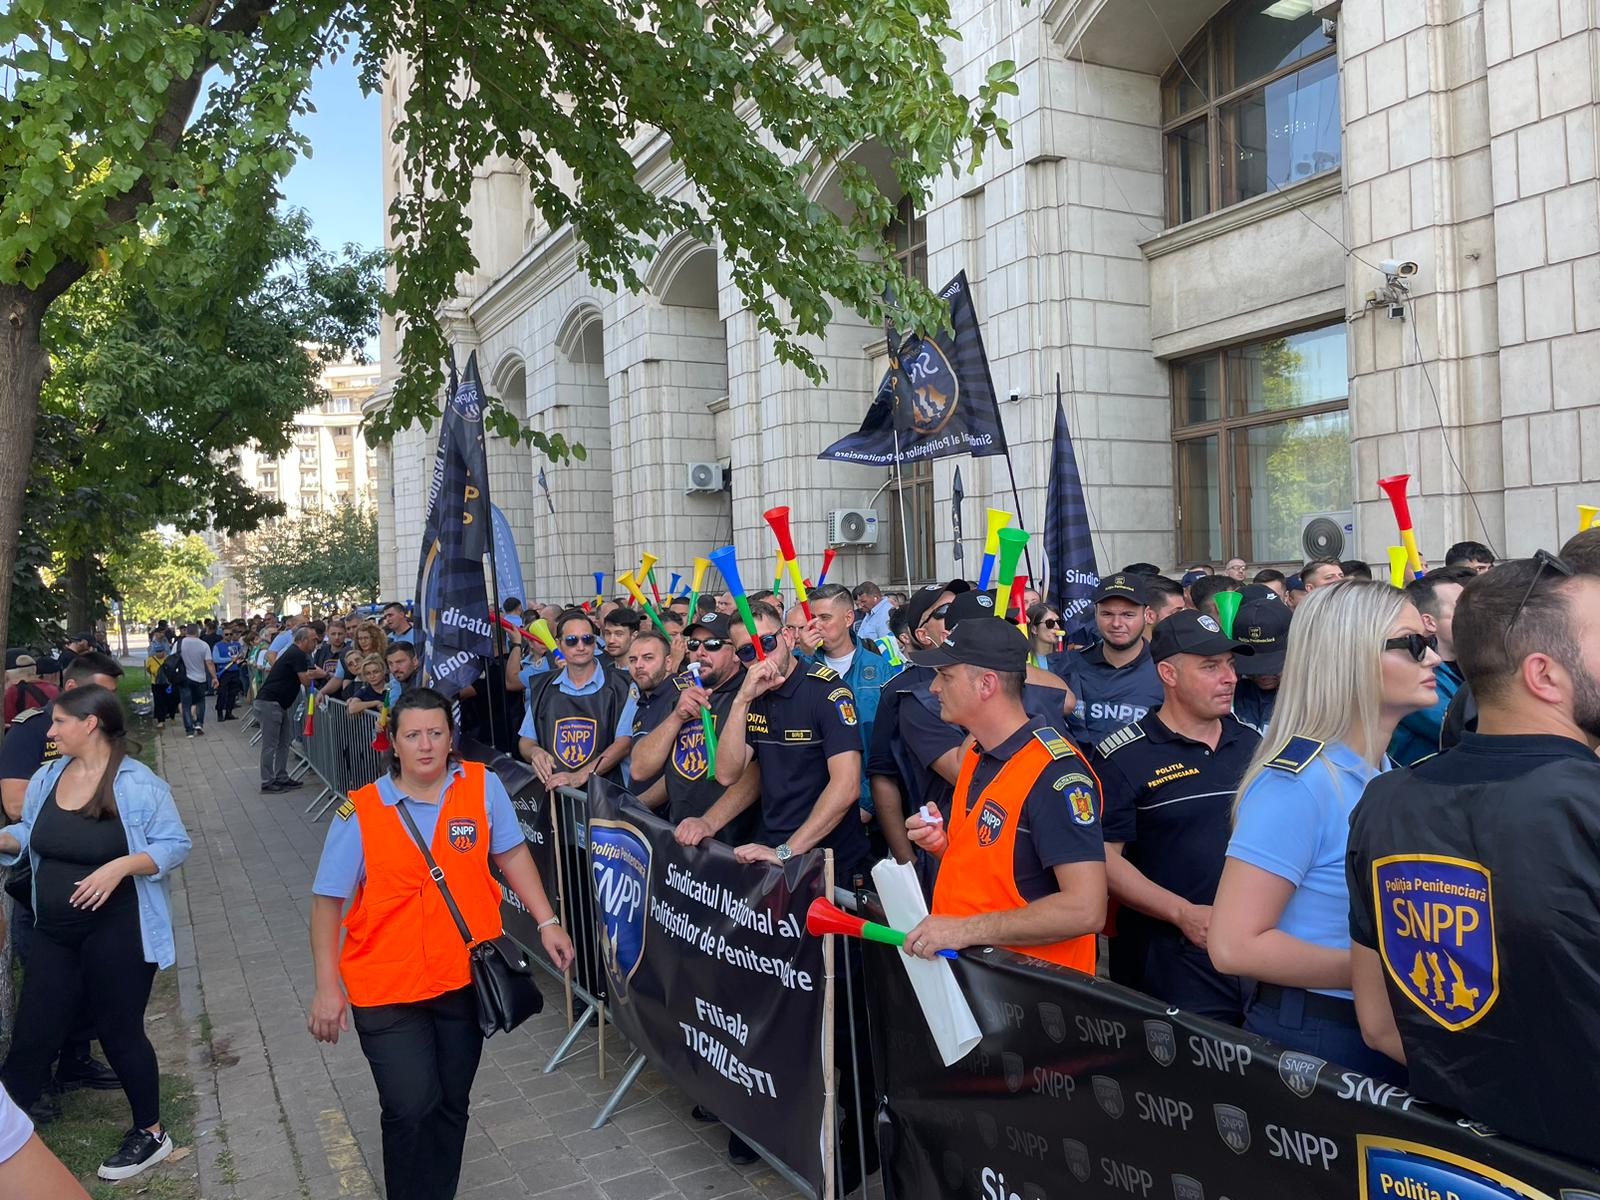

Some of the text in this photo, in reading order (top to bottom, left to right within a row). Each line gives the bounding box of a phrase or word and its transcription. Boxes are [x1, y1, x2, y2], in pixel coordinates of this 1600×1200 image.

[1065, 569, 1100, 588] Sindic
[441, 606, 493, 638] dicatu
[560, 730, 590, 743] SNPP
[1090, 703, 1148, 722] SNPP
[451, 826, 474, 836] SNPP
[981, 809, 1001, 829] SNPP
[592, 861, 642, 923] SNPP
[665, 862, 801, 939] Sindicatul Național al
[1385, 877, 1487, 903] Poliția Penitenciară
[650, 895, 700, 945] Polițiștilor
[700, 926, 716, 956] de
[1392, 897, 1480, 947] SNPP
[695, 996, 749, 1047] Filiala
[983, 1000, 1025, 1029] SNPP
[1075, 1015, 1127, 1049] SNPP
[1188, 1035, 1252, 1077] SNPP
[1284, 1059, 1315, 1073] SNPP
[679, 1021, 777, 1099] TICHILEȘTI
[1031, 1066, 1076, 1101] SNPP
[1134, 1091, 1193, 1131] SNPP
[1265, 1123, 1339, 1171] SNPP
[1005, 1126, 1049, 1161] SNPP
[1100, 1157, 1153, 1198] SNPP
